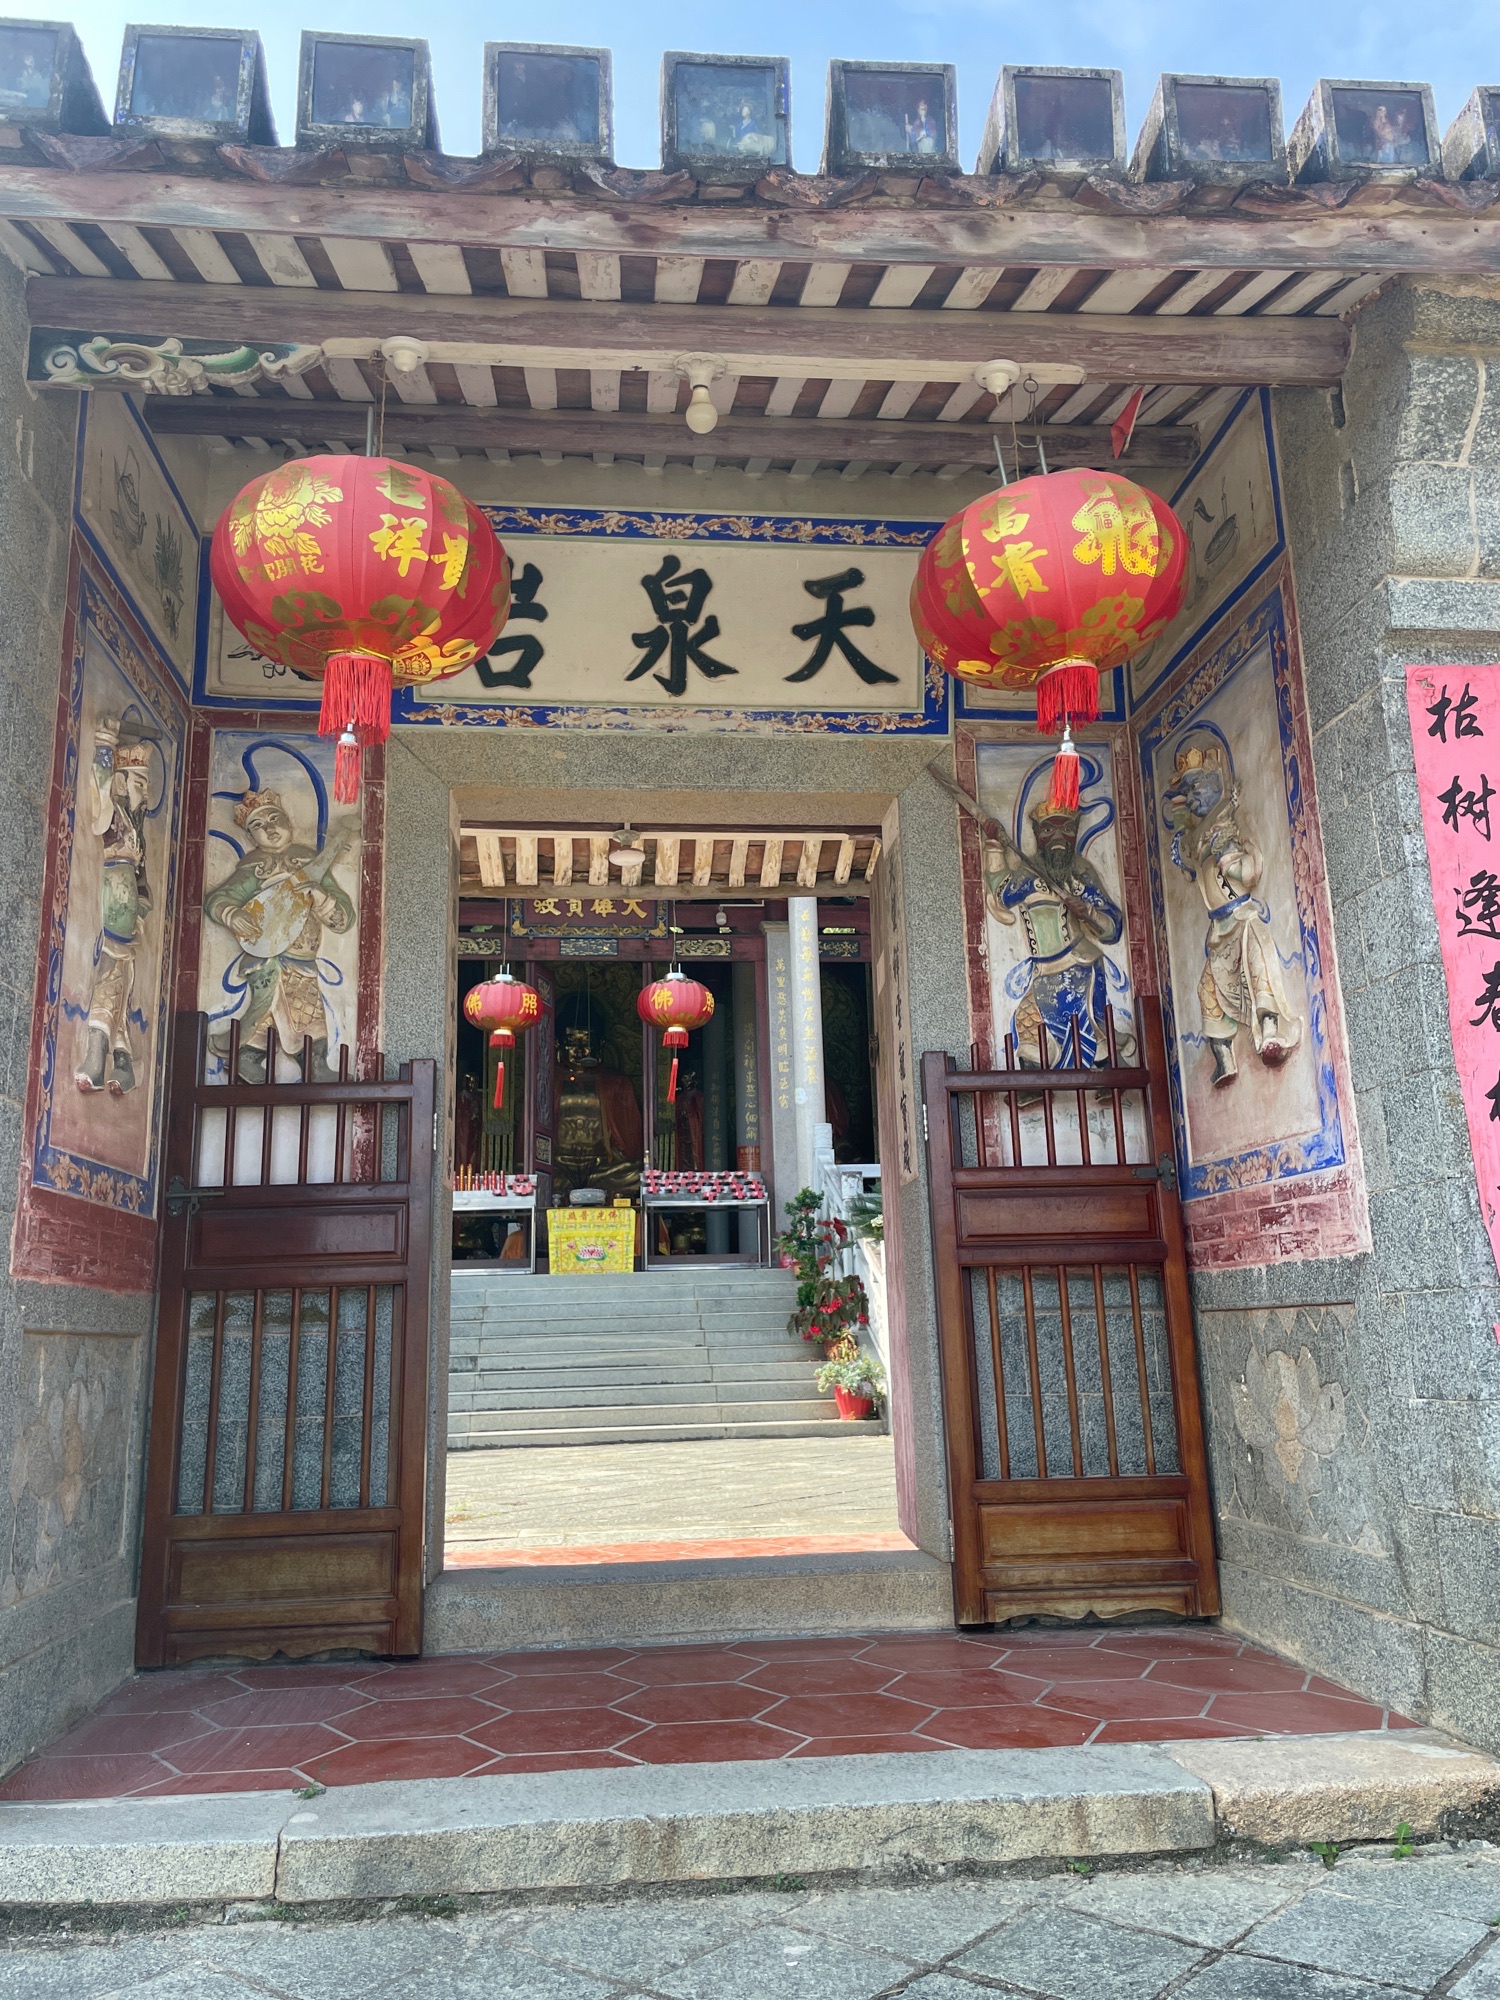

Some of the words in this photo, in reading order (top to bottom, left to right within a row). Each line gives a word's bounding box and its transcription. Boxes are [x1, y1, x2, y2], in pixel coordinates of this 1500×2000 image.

[977, 492, 1050, 602] 富貴
[465, 991, 483, 1016] 佛
[518, 992, 538, 1016] 照
[651, 987, 674, 1012] 佛
